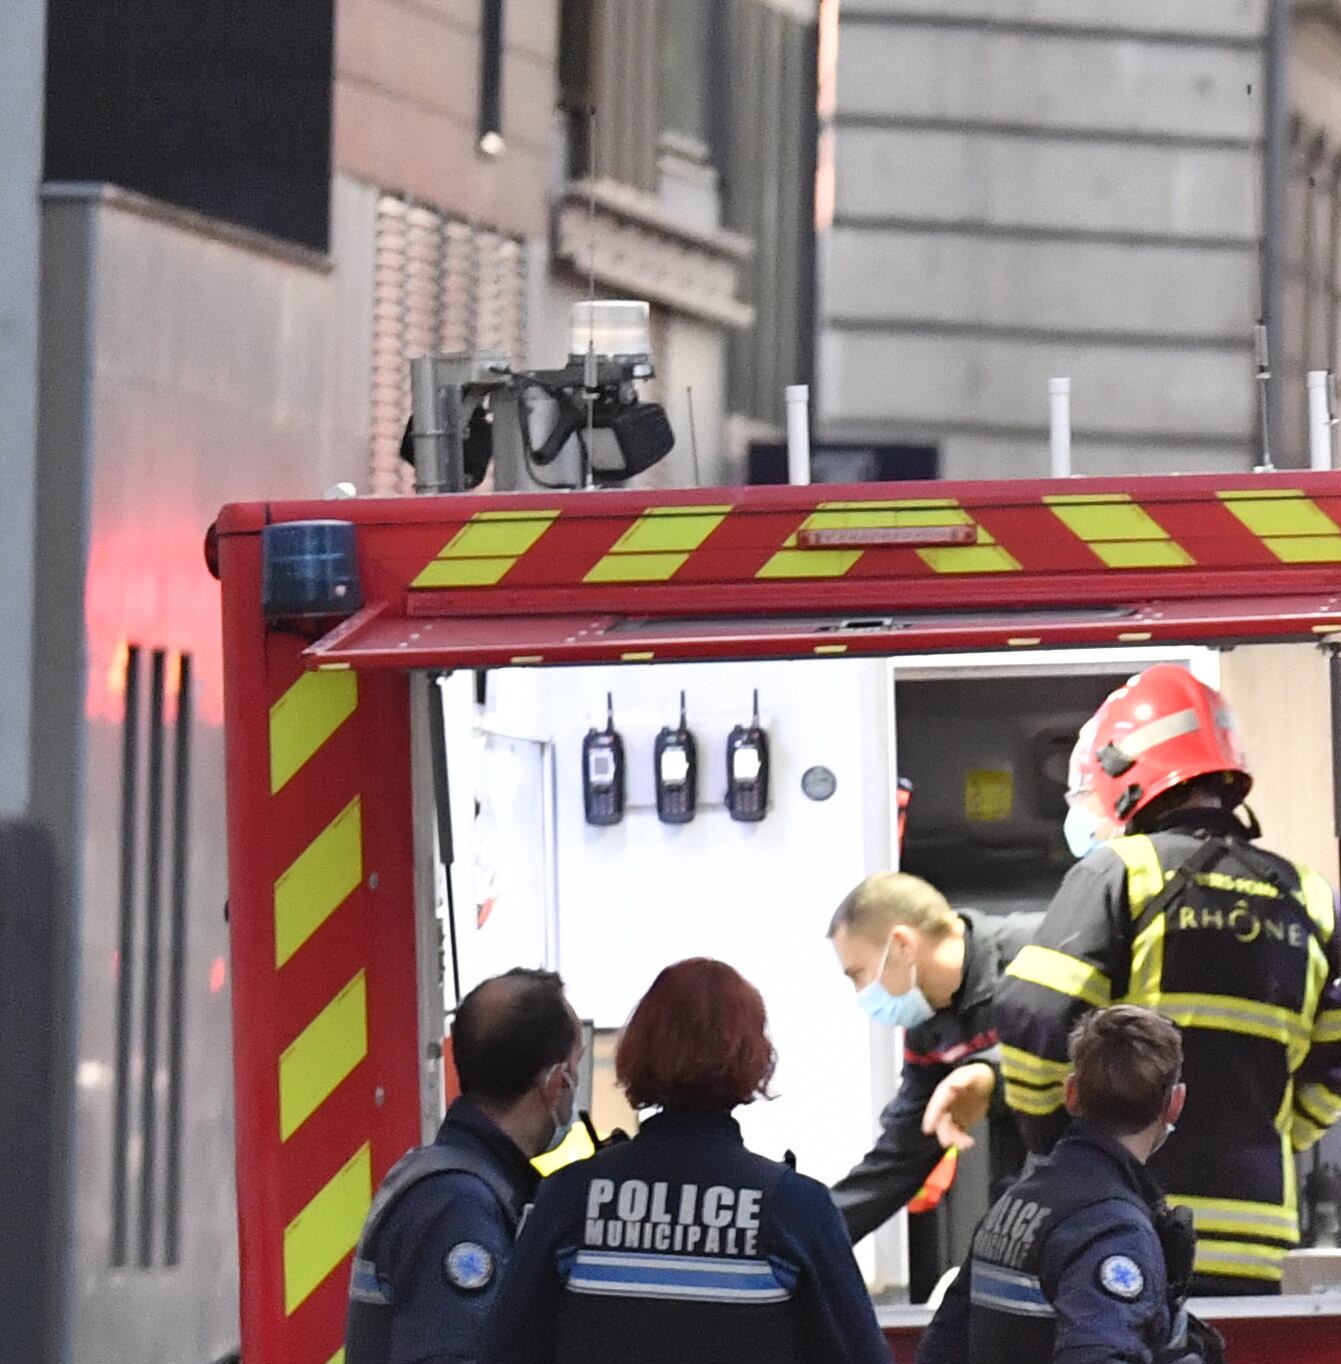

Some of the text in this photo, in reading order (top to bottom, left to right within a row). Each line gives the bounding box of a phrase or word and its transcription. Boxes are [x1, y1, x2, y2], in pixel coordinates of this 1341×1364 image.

[1179, 899, 1302, 948] RHÔNE
[585, 1178, 763, 1229] POLICE
[584, 1218, 759, 1255] MUNICIPALE
